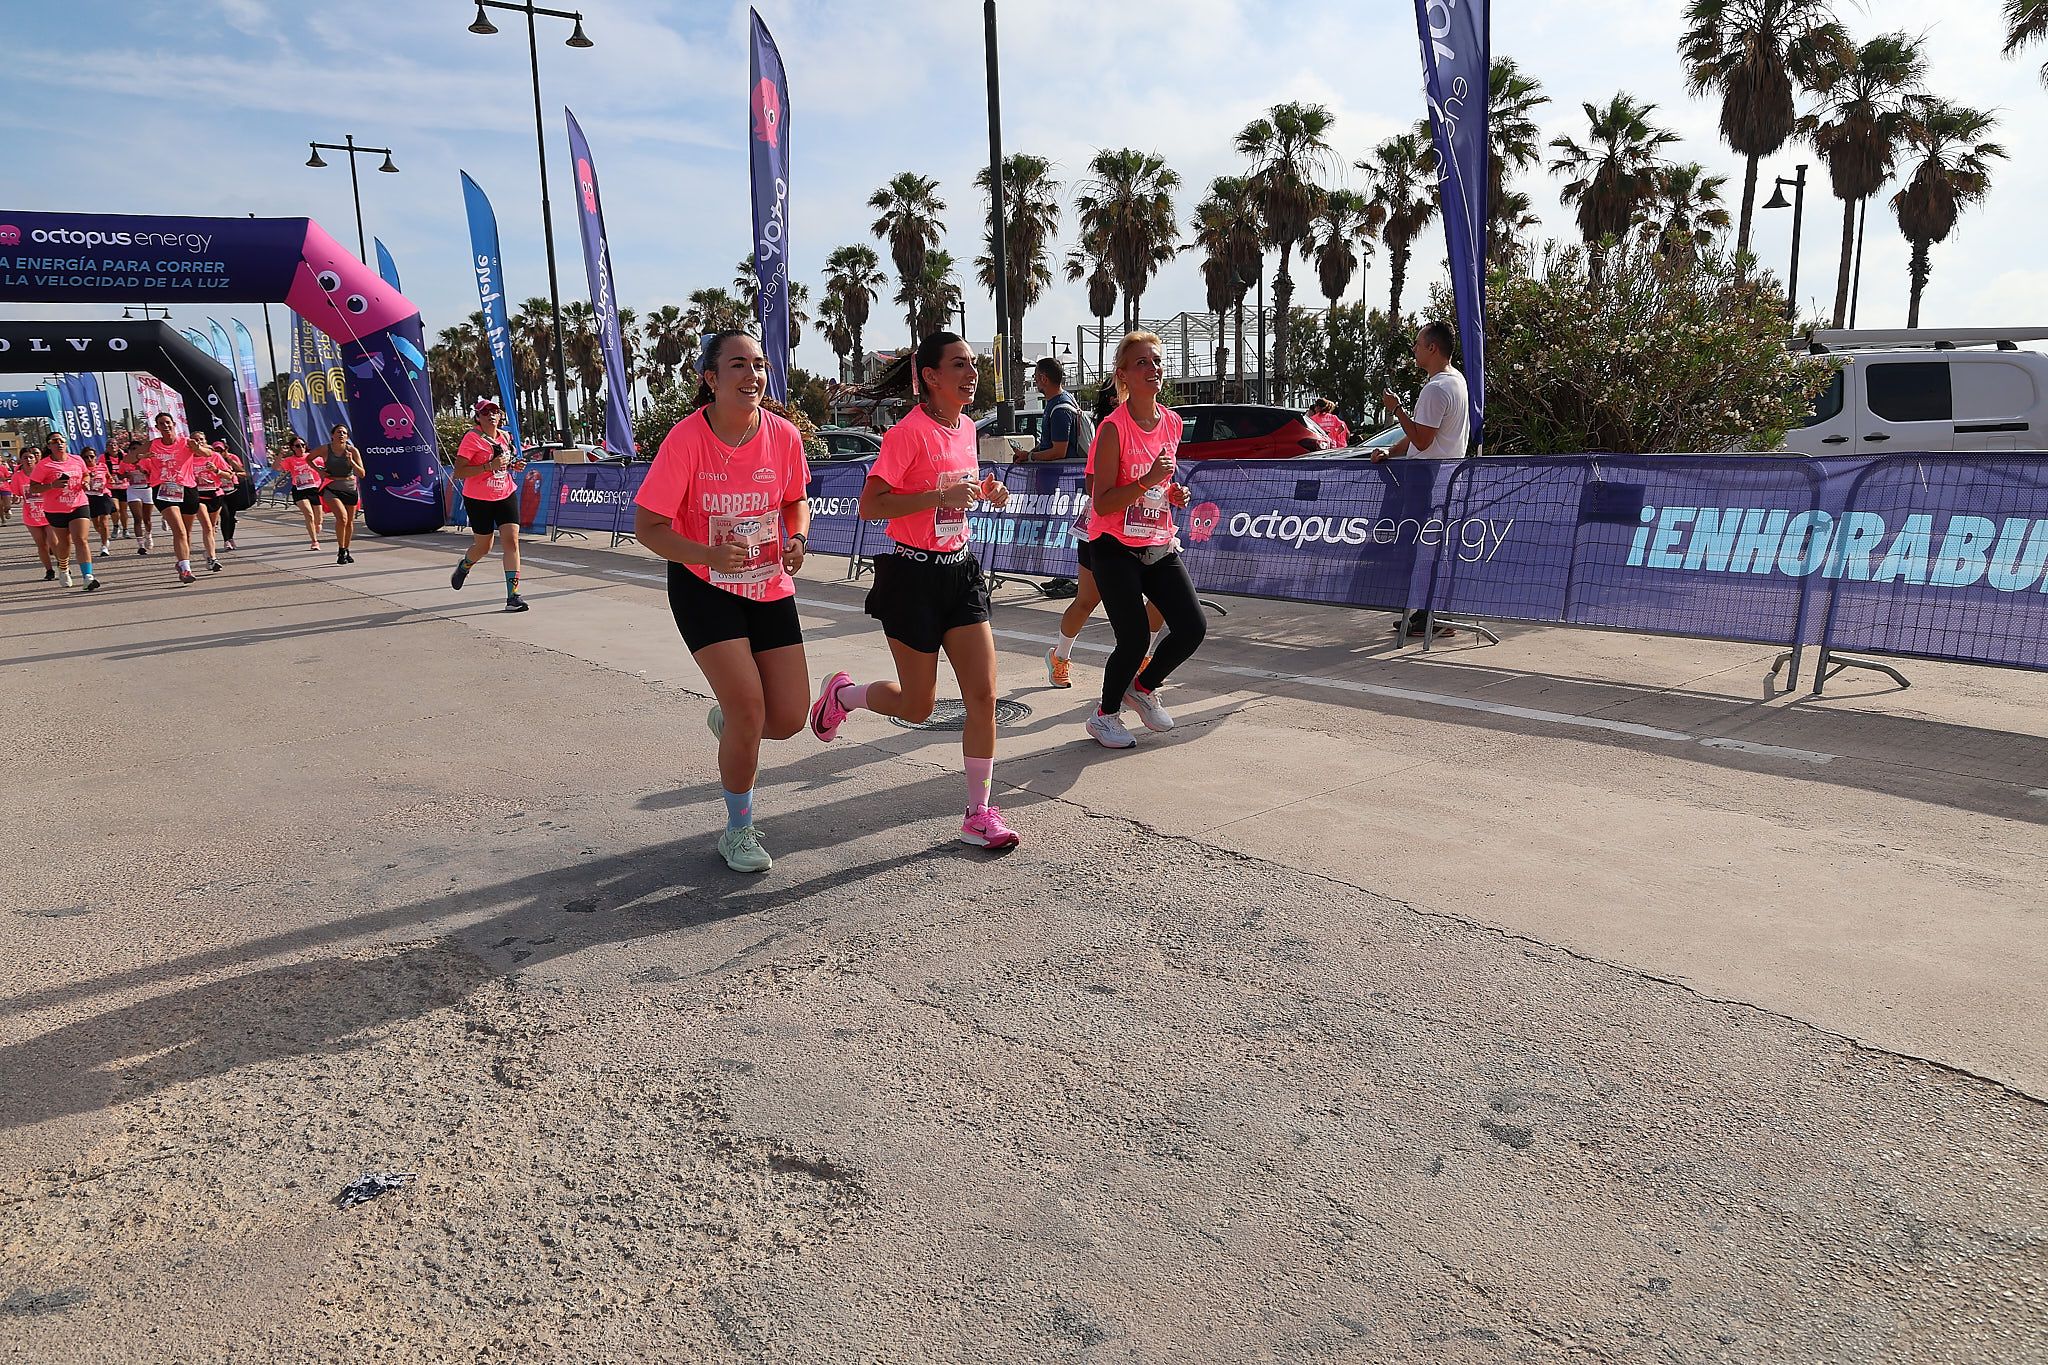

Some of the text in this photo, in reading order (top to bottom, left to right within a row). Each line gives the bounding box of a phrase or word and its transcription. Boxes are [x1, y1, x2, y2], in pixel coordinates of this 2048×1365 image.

[31, 228, 213, 254] octopus energy
[15, 255, 98, 272] ENERGÍA
[102, 259, 151, 273] PARA
[156, 261, 225, 273] CORRER
[5, 274, 231, 289] LA VELOCIDAD DE LA LUZ
[0, 338, 129, 352] OLVO
[366, 444, 405, 456] octopus
[698, 471, 728, 482] OYSHO
[570, 486, 633, 511] octopus energy
[702, 491, 769, 513] CARRERA
[1143, 508, 1161, 519] 016
[1016, 520, 1042, 547] DE
[1043, 520, 1069, 549] LA
[1229, 509, 1514, 564] octopus energy
[895, 545, 928, 562] PRO
[935, 548, 965, 565] NIKE
[1626, 504, 2048, 593] ¡ENHORABU
